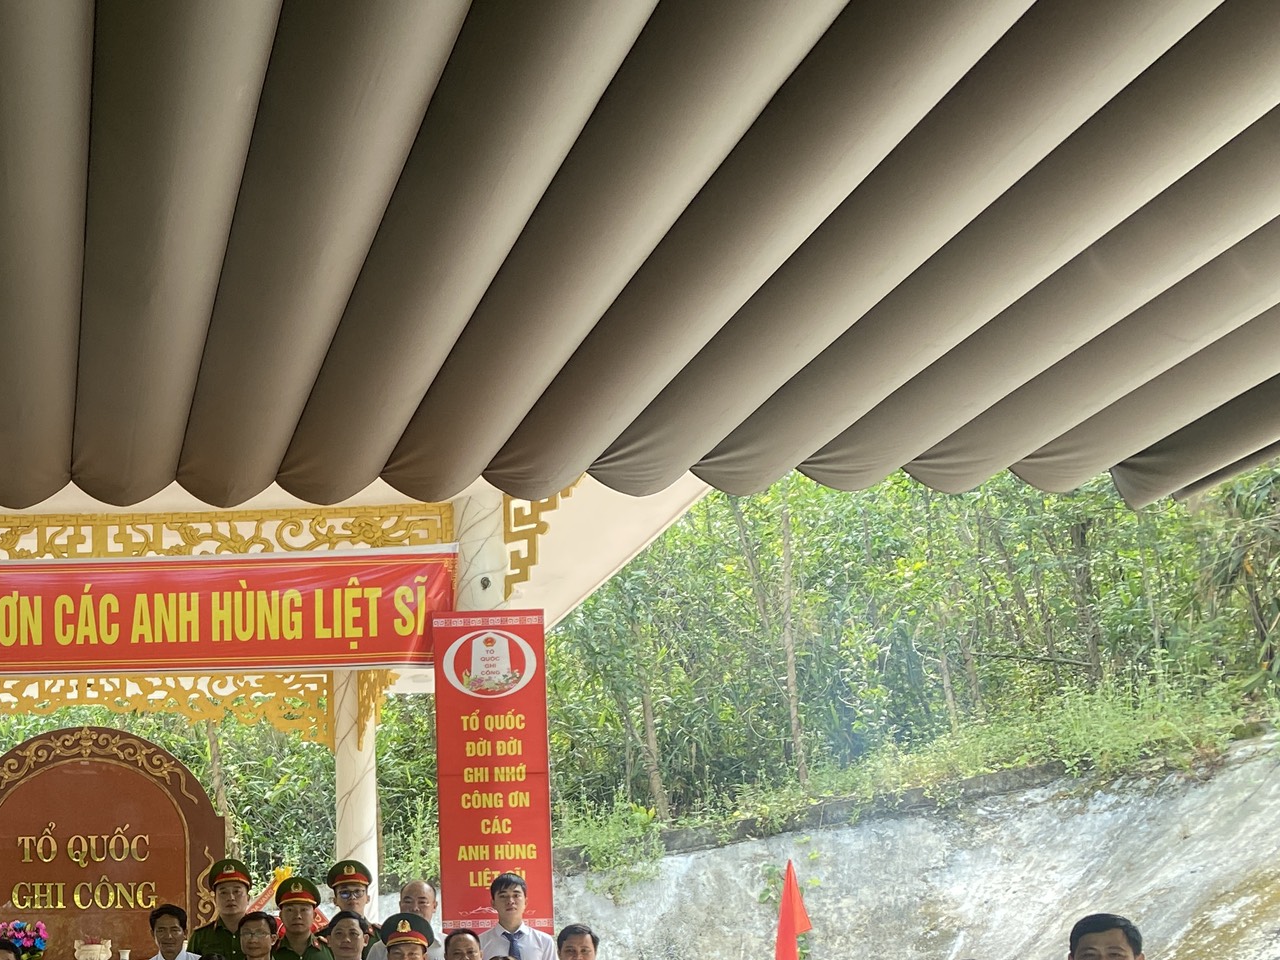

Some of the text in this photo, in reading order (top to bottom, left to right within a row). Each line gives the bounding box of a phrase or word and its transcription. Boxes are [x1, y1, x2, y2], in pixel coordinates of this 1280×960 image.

[53, 582, 120, 645] CÁC
[129, 592, 200, 645] ANH
[211, 581, 303, 642] HÙNG
[314, 577, 380, 650] LIỆT
[393, 577, 430, 637] SĨ
[460, 708, 526, 732] TỔ QUỐC
[465, 737, 522, 757] ĐỜI ĐỜI
[463, 763, 527, 783] GHI NHỚ
[460, 790, 530, 809] CÔNG ƠN
[480, 816, 512, 835] CÁC
[17, 822, 150, 868] TỔ QUỐC
[457, 841, 537, 861] ANH HÙNG
[11, 875, 158, 910] GHI CÔNG
